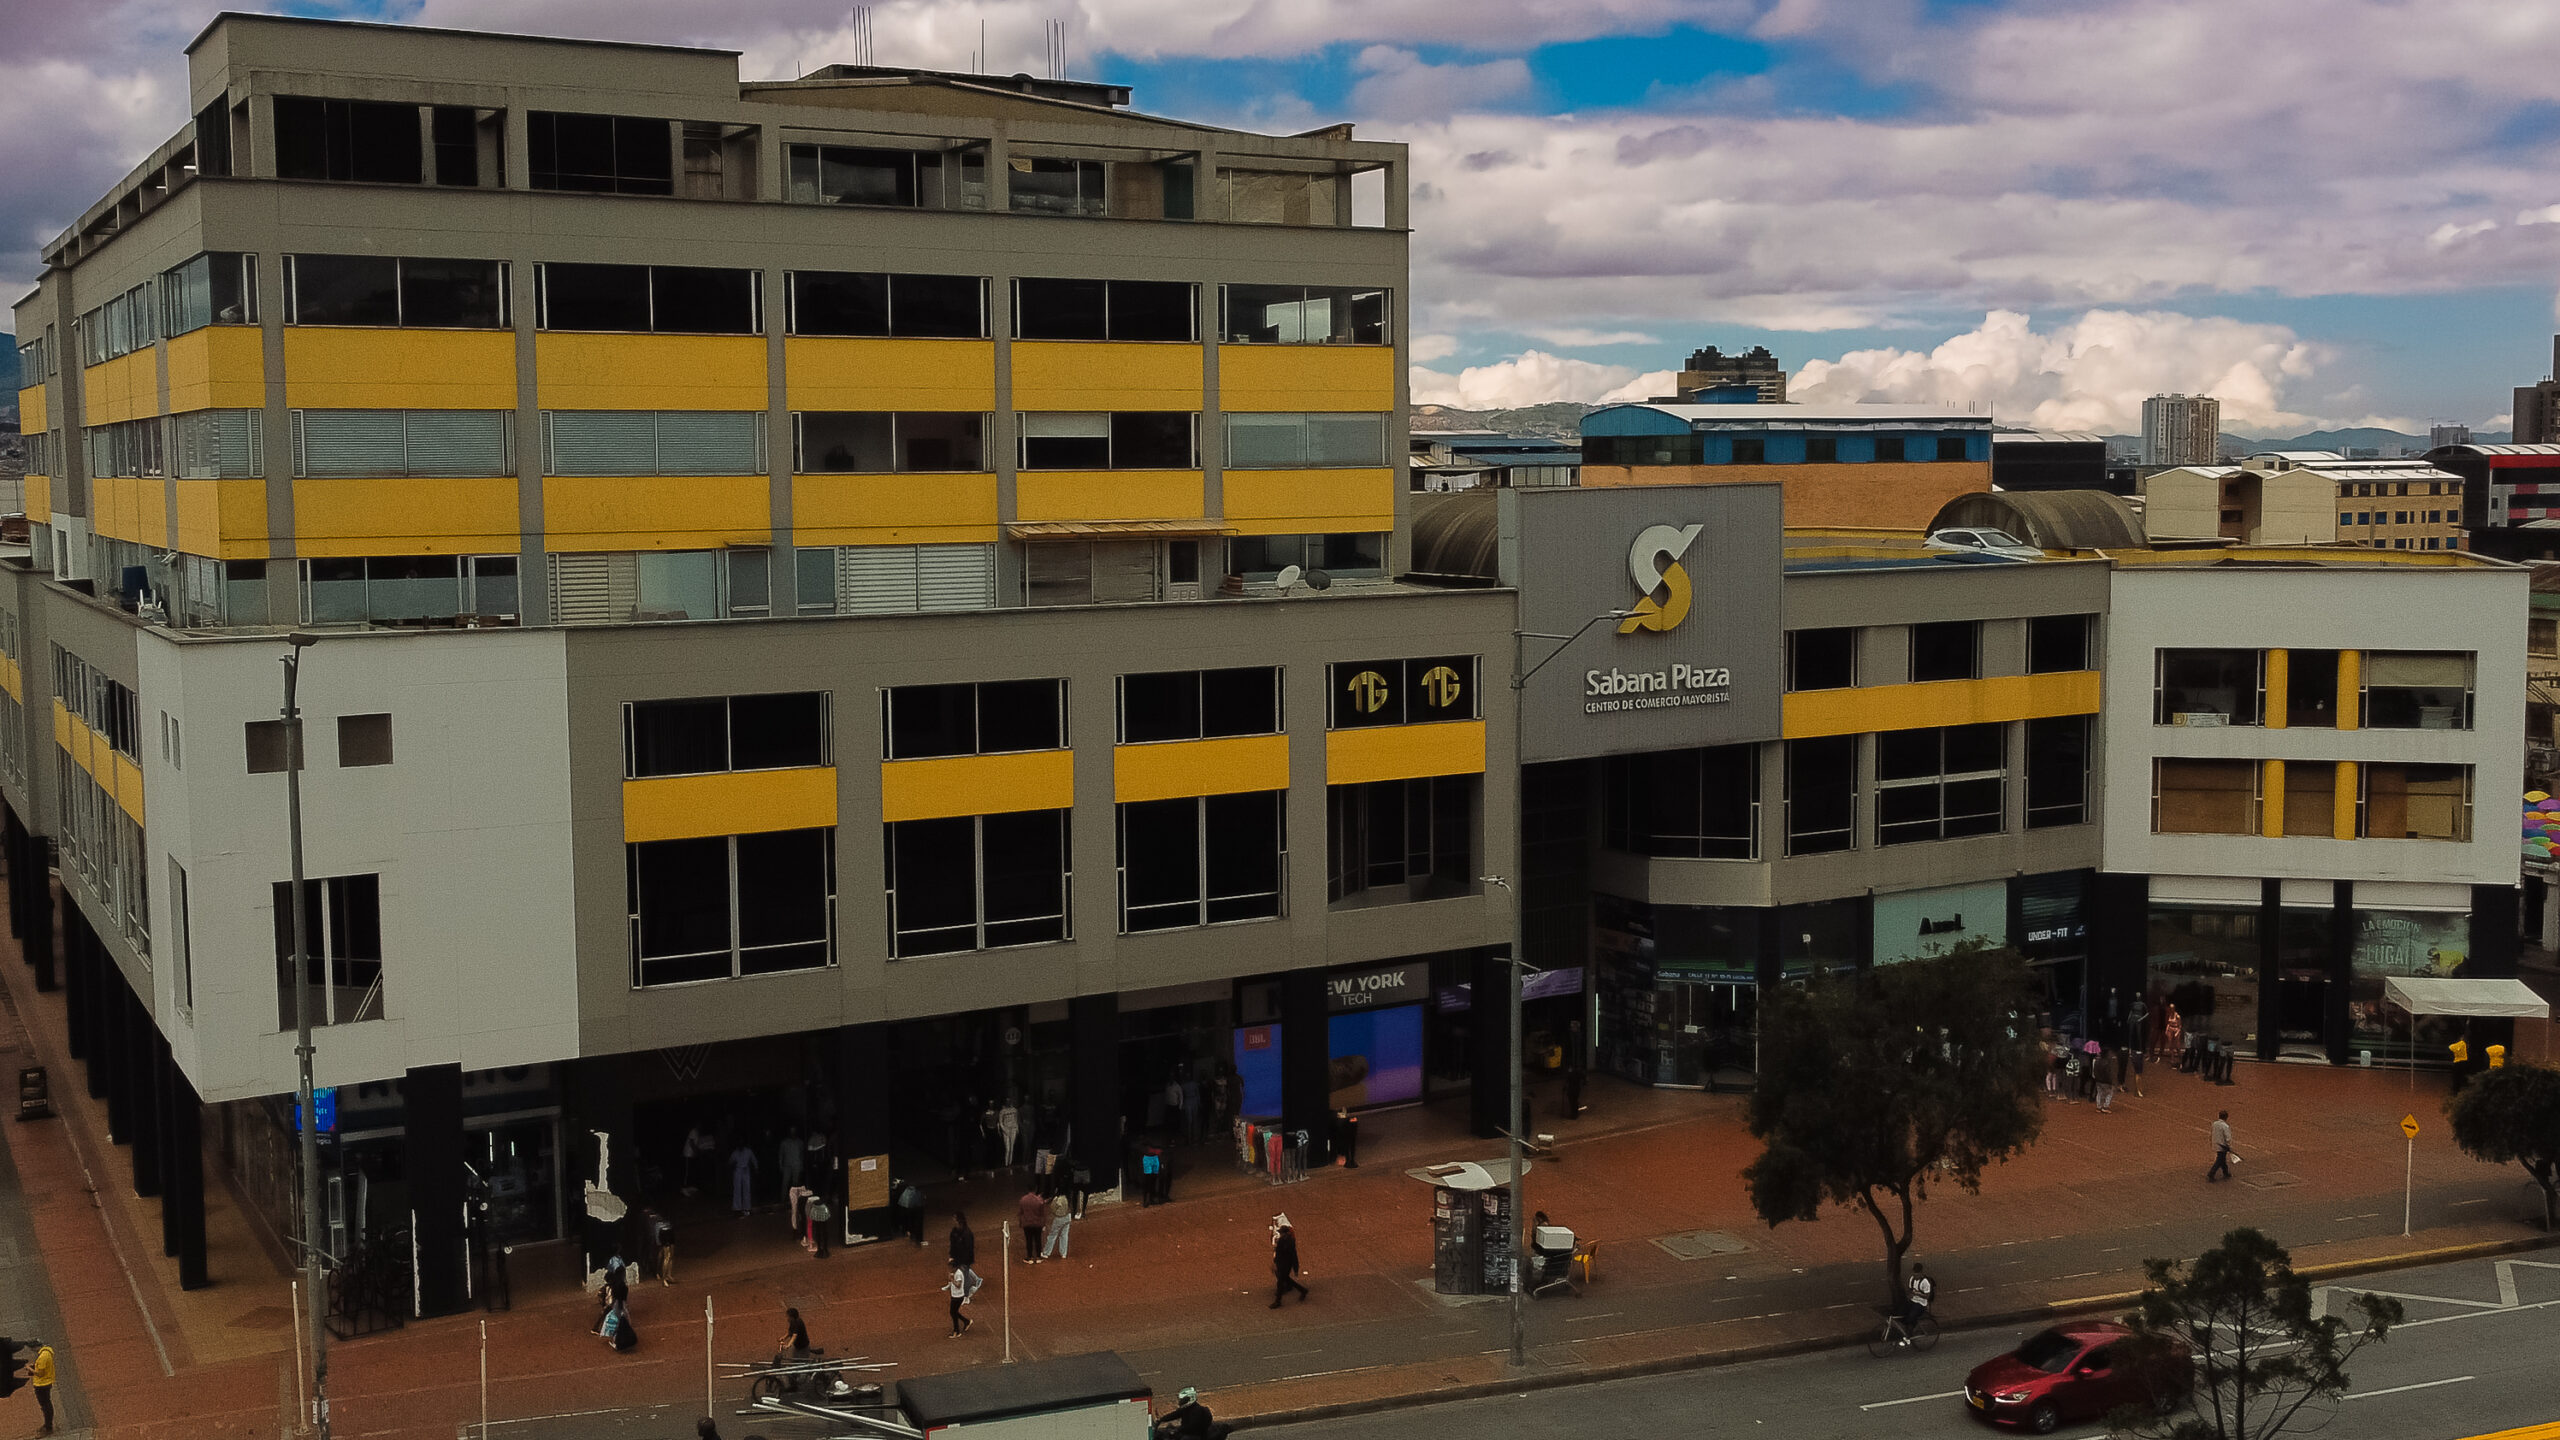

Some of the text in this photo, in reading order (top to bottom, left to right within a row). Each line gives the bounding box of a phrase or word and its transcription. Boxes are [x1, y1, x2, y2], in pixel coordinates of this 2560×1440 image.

[1586, 663, 1730, 696] Sabana Plaza
[1585, 692, 1730, 713] CENTRO DE COMERCIO MAYORISTA
[1327, 971, 1406, 996] EW YORK
[1341, 992, 1373, 1006] TECH
